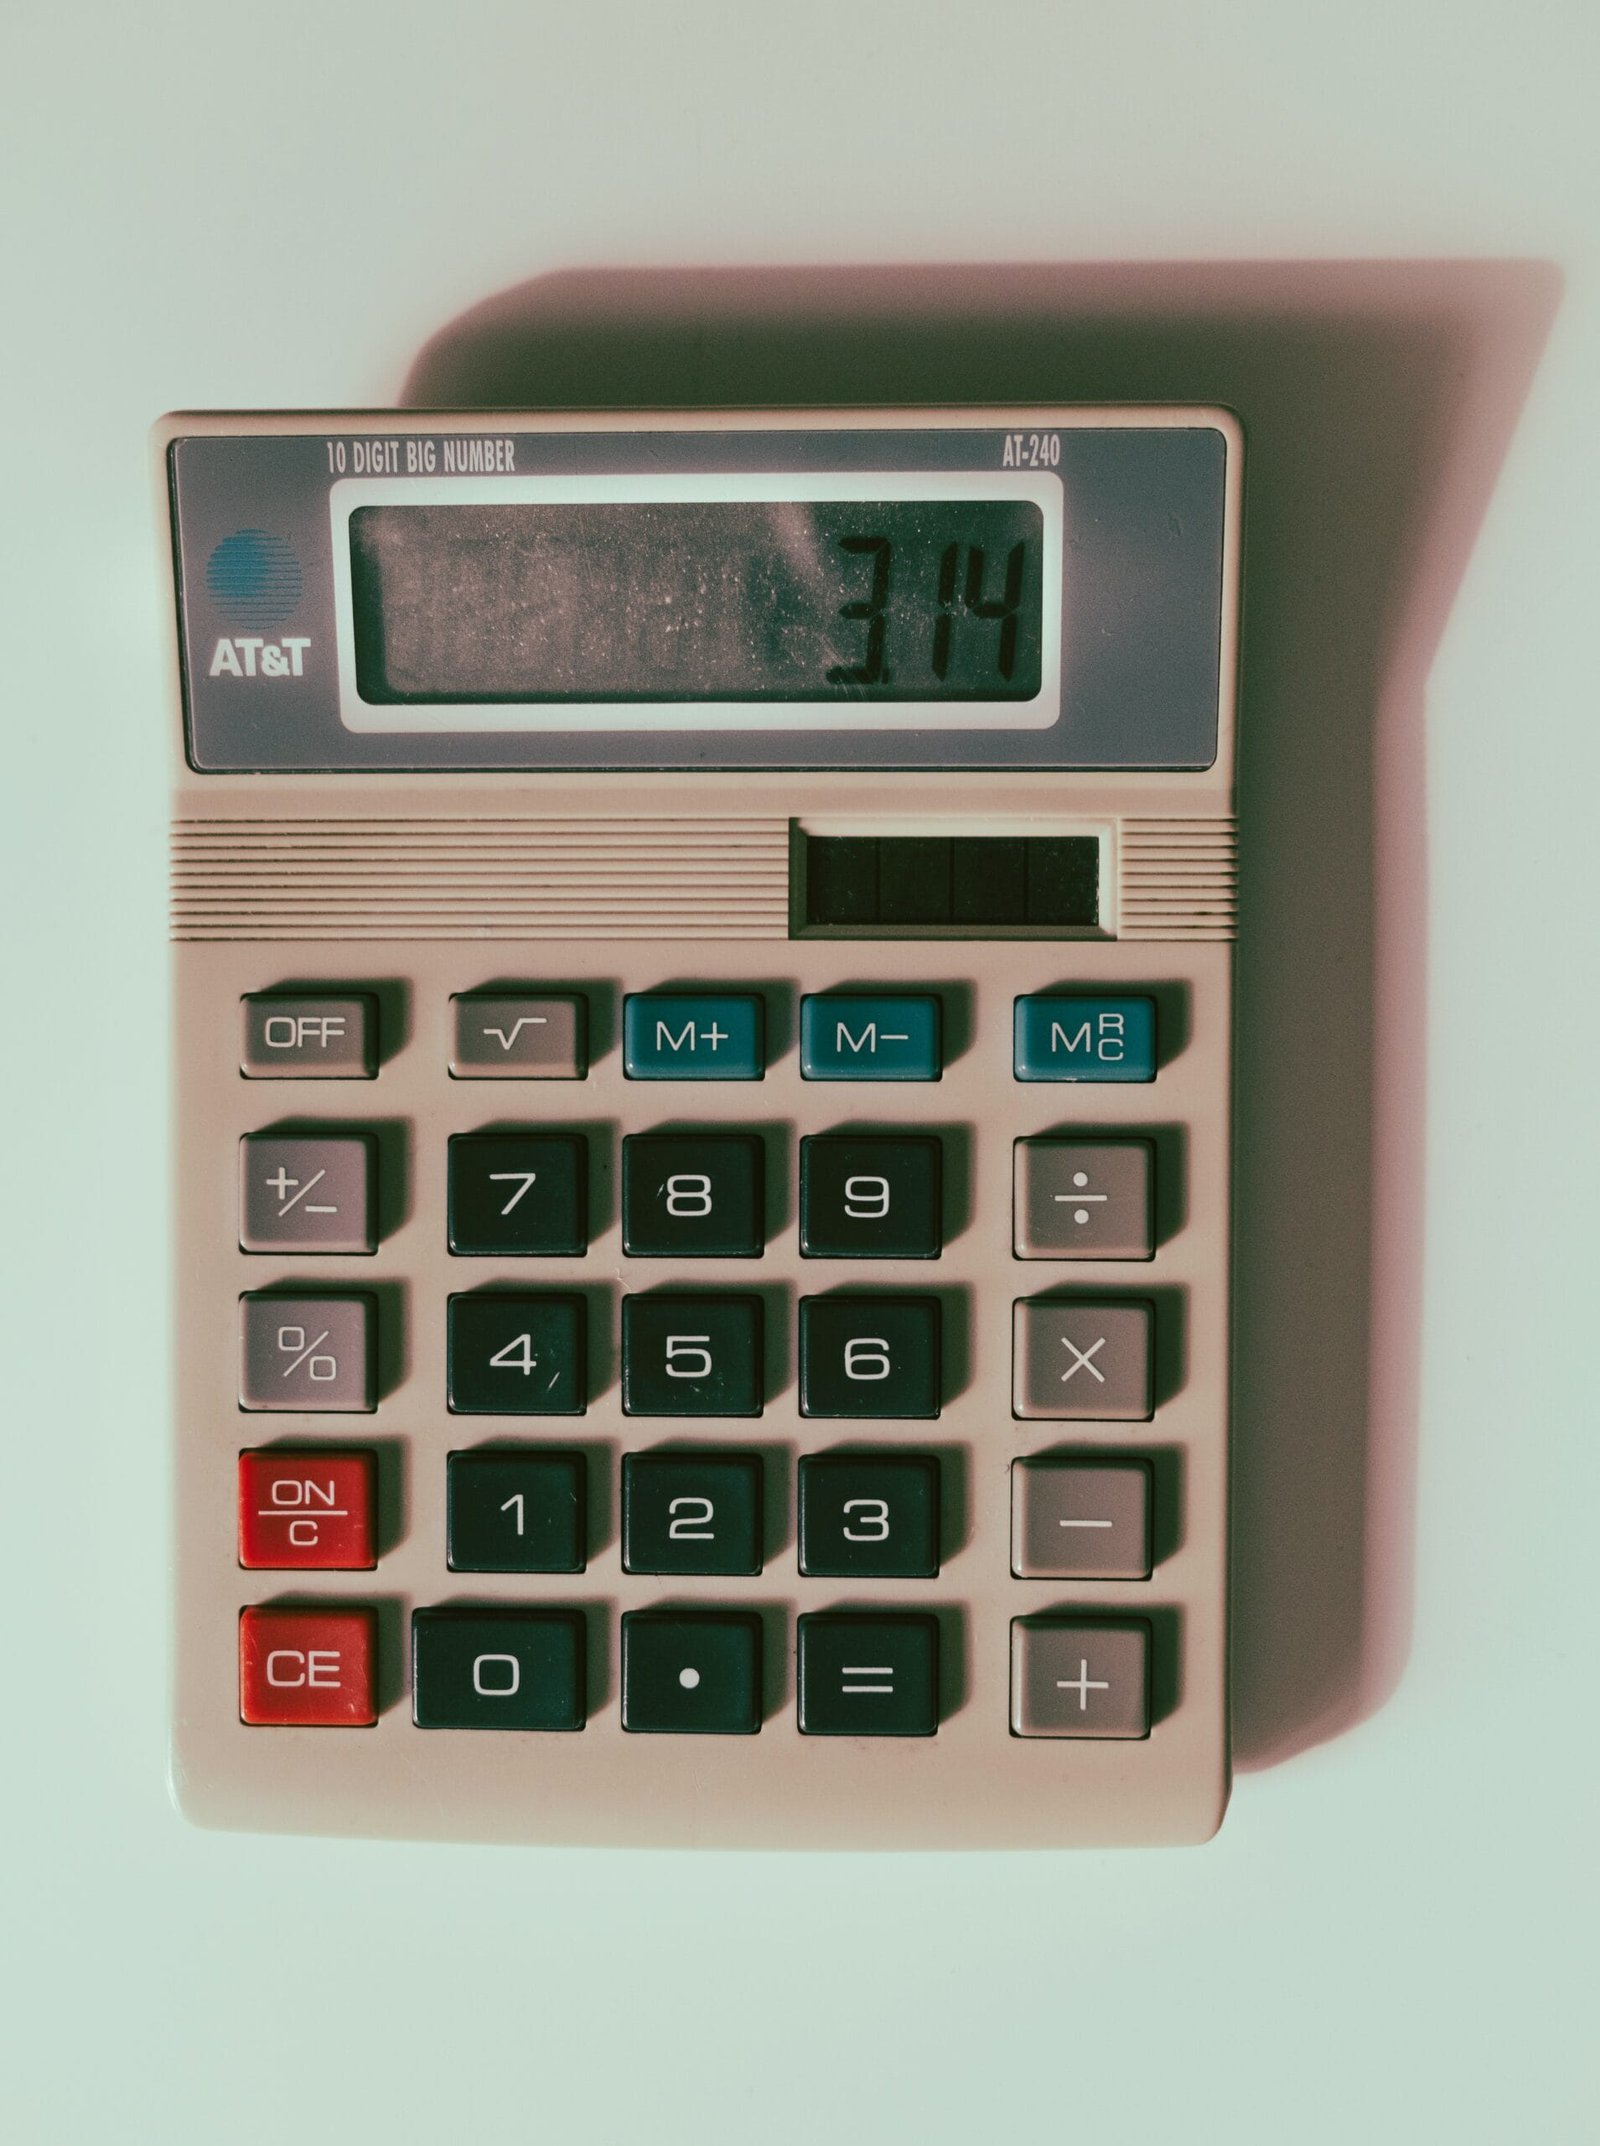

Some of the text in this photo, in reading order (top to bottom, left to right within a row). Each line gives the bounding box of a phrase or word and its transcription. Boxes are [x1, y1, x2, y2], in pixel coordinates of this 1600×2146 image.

[327, 440, 515, 474] 10 DIGIT BIG NUMBER
[1003, 434, 1060, 467] AT-240
[826, 536, 1025, 685] 3.14
[209, 638, 311, 677] AT&T
[265, 1017, 345, 1048] OFF
[656, 1021, 728, 1051] M+
[836, 1022, 909, 1053] M-
[489, 1173, 536, 1215] 7
[666, 1174, 712, 1217] 8
[844, 1176, 889, 1218] 9
[278, 1326, 337, 1381] %
[489, 1334, 537, 1376] 4
[666, 1336, 712, 1378] 5
[844, 1338, 890, 1380] 6
[271, 1479, 335, 1506] ON
[289, 1520, 319, 1546] C
[500, 1494, 524, 1536] 1
[668, 1497, 714, 1540] 2
[843, 1499, 889, 1542] 3
[266, 1650, 341, 1688] CE
[473, 1654, 520, 1696] 0
